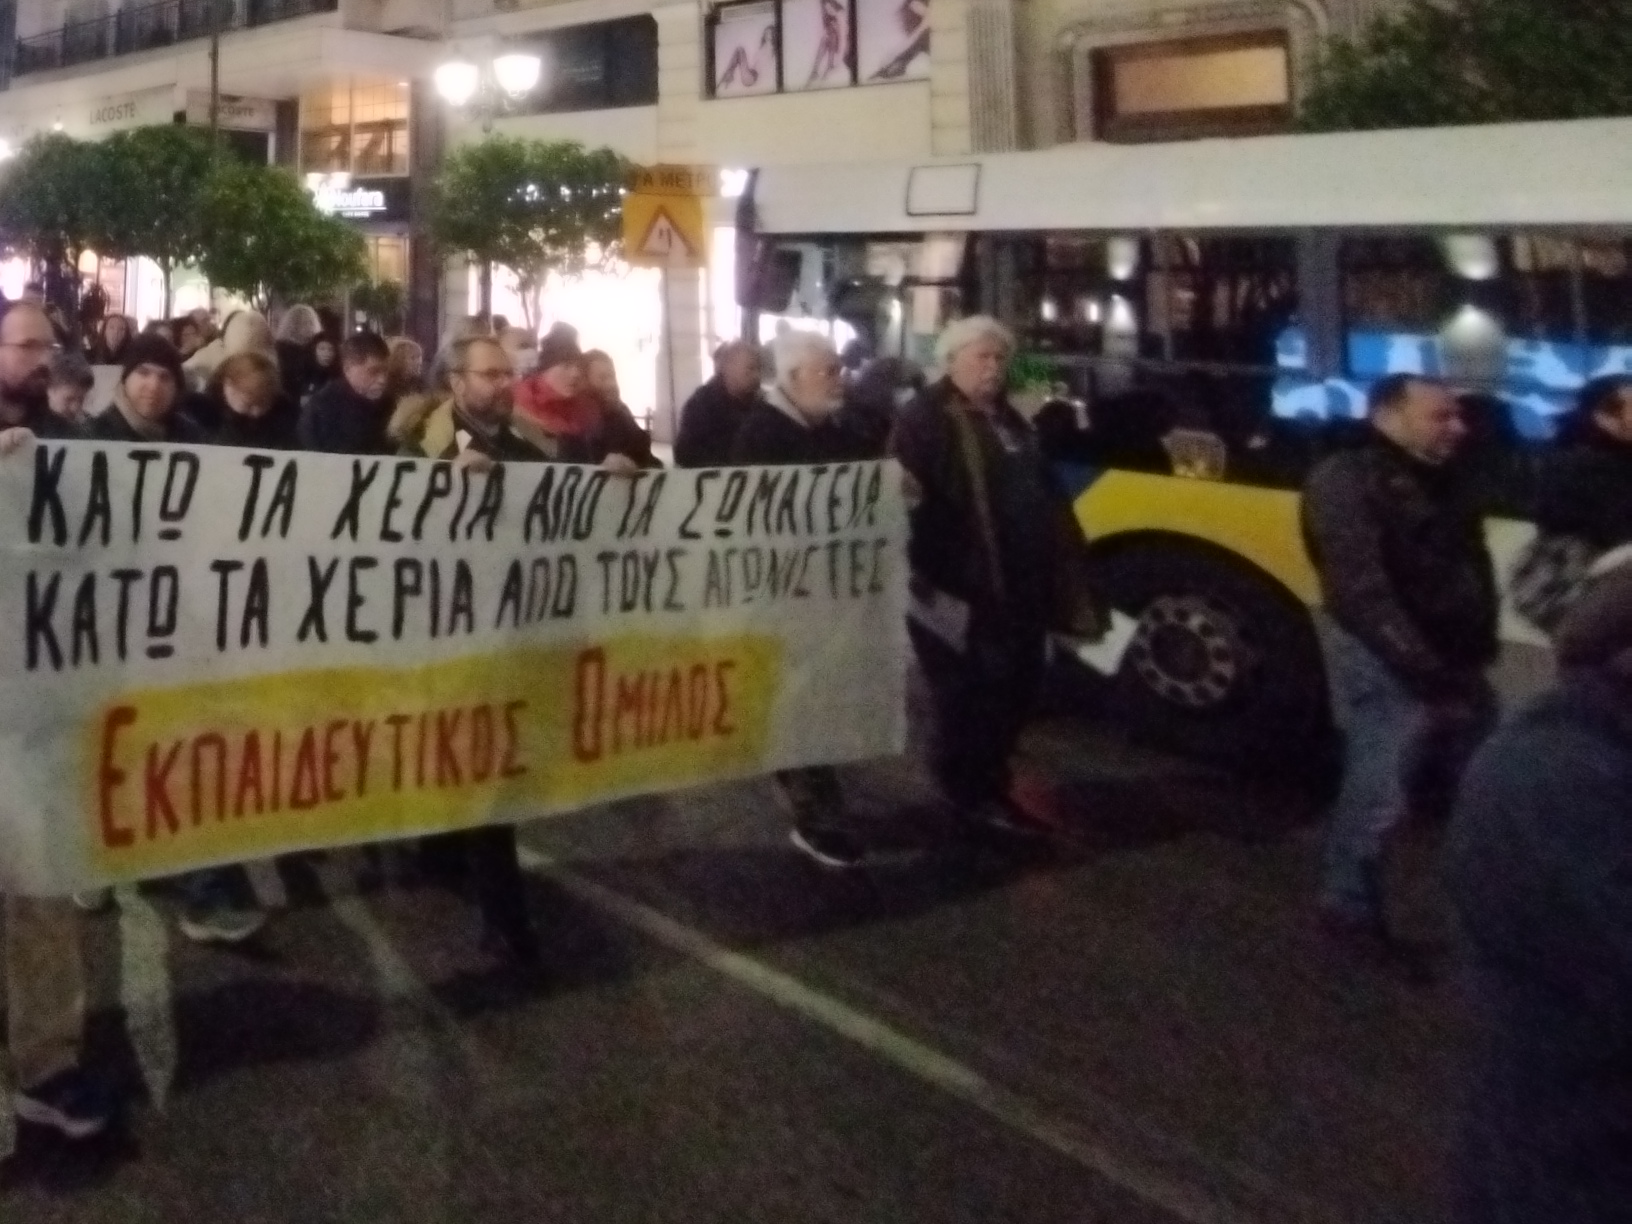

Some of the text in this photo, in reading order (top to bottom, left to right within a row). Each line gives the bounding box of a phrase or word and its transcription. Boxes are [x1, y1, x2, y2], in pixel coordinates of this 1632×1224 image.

[89, 102, 135, 124] LACOSTE
[209, 106, 255, 116] COSTE
[26, 444, 200, 547] ΚΑΤΩ
[237, 453, 298, 543] ΤΑ
[330, 459, 506, 542] ΧΕΡΙΑ
[523, 465, 608, 543] ΑΠΟ
[616, 469, 667, 539] ΤΑ
[24, 564, 180, 673] ΚΑΤΩ
[209, 556, 269, 653] ΤΑ
[296, 555, 475, 645] ΧΕΡΙΑ
[495, 553, 578, 630] ΑΠΟ
[597, 548, 689, 614] ΤΟΥΣ
[99, 646, 738, 848] ΕΚΠΑΙΔΕΥΤΙΚΟΣ ΟΜΙΛΟΣ
